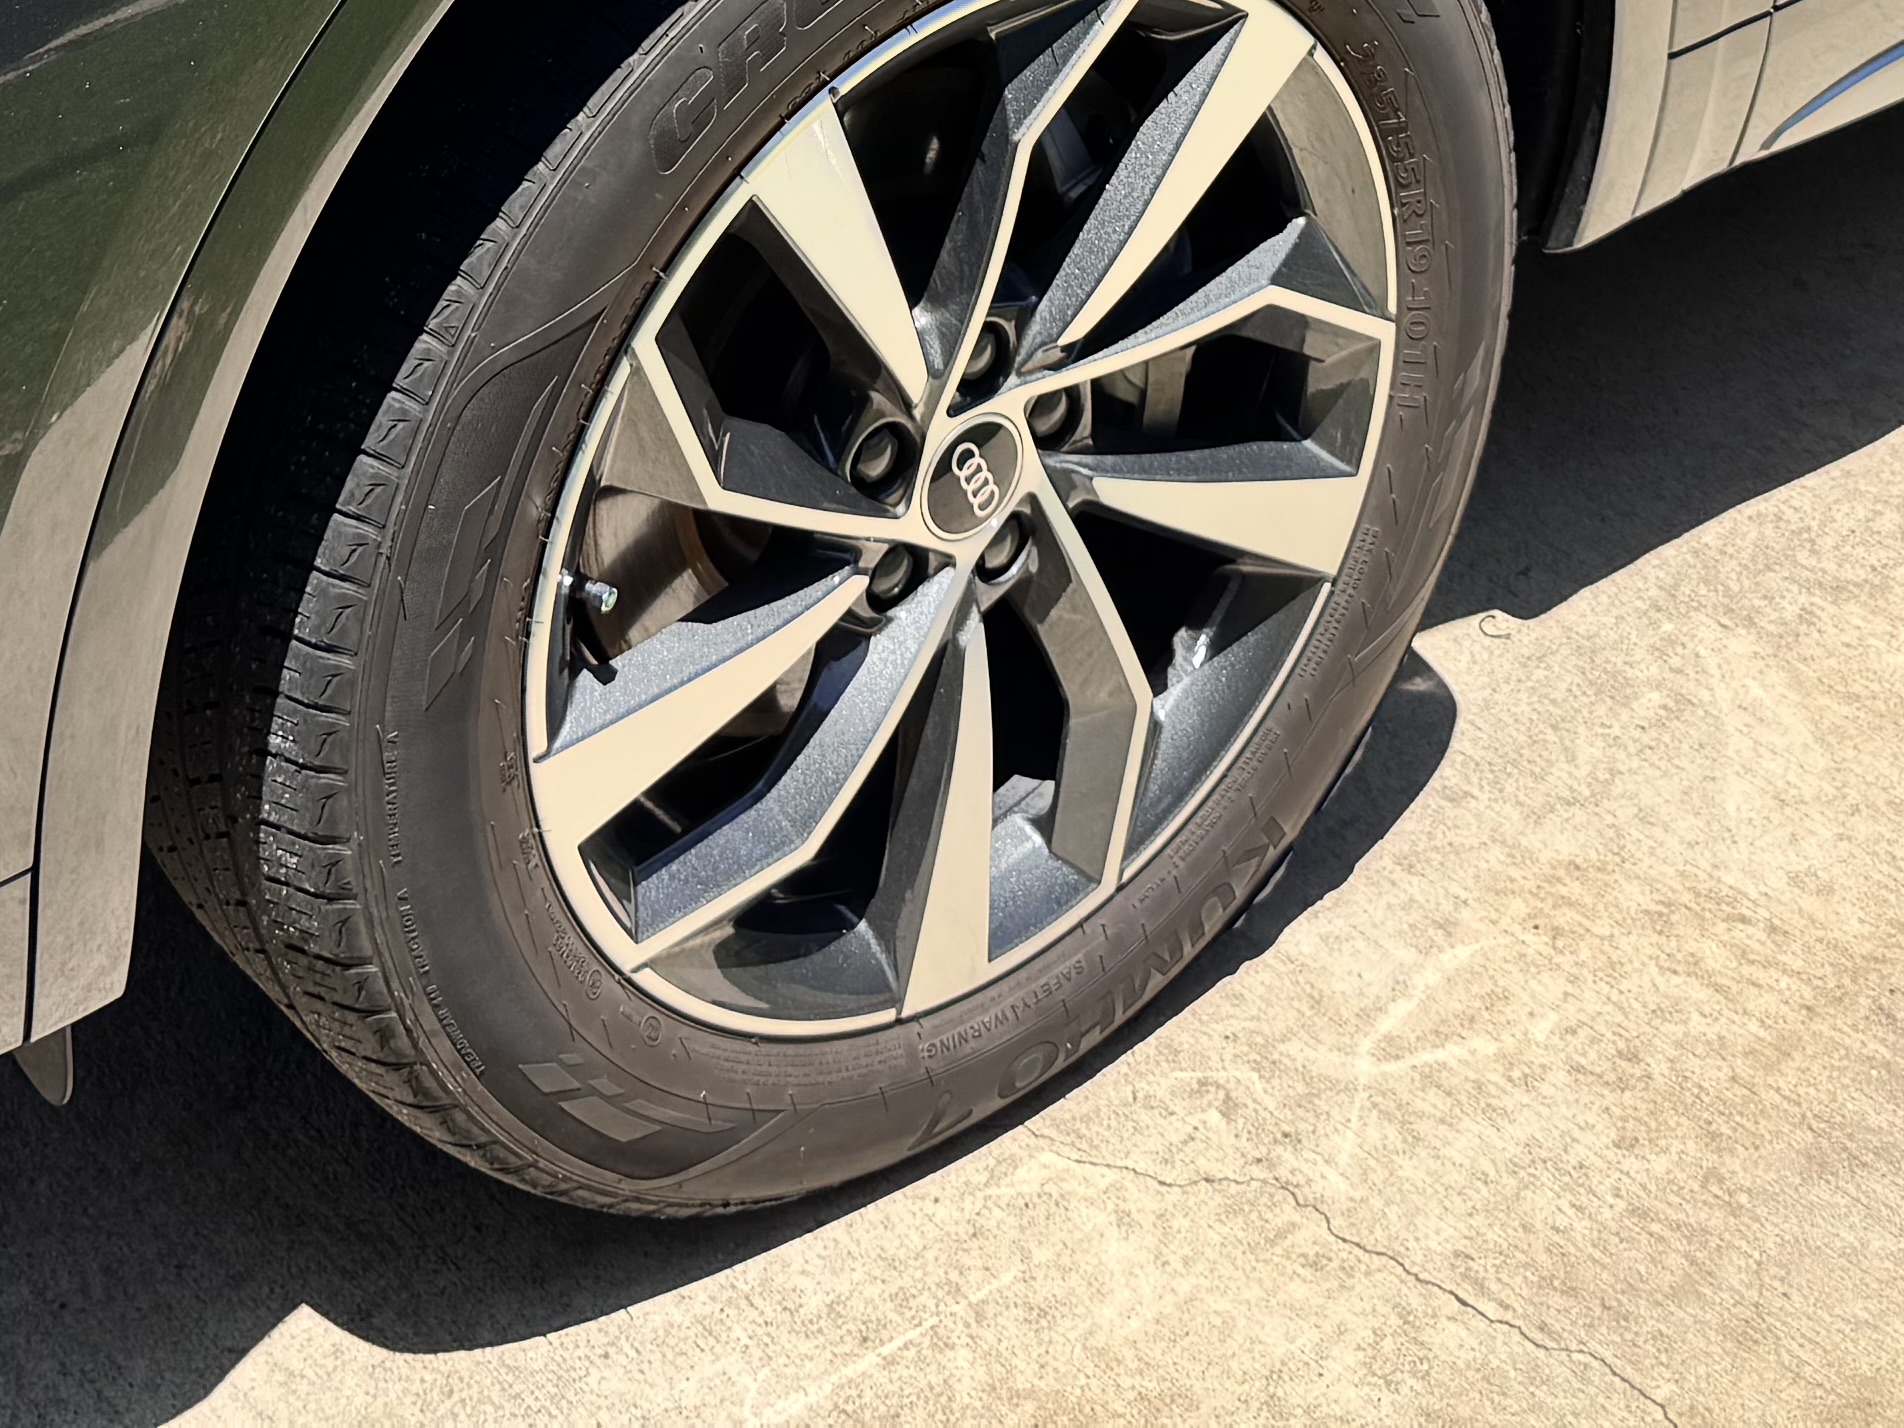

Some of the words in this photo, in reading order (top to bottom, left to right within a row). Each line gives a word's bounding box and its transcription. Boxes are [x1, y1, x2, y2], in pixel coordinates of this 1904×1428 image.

[997, 815, 1287, 1100] KUMHO
[1020, 958, 1086, 1016] SAFETY
[442, 1006, 486, 1077] TREADWEAR
